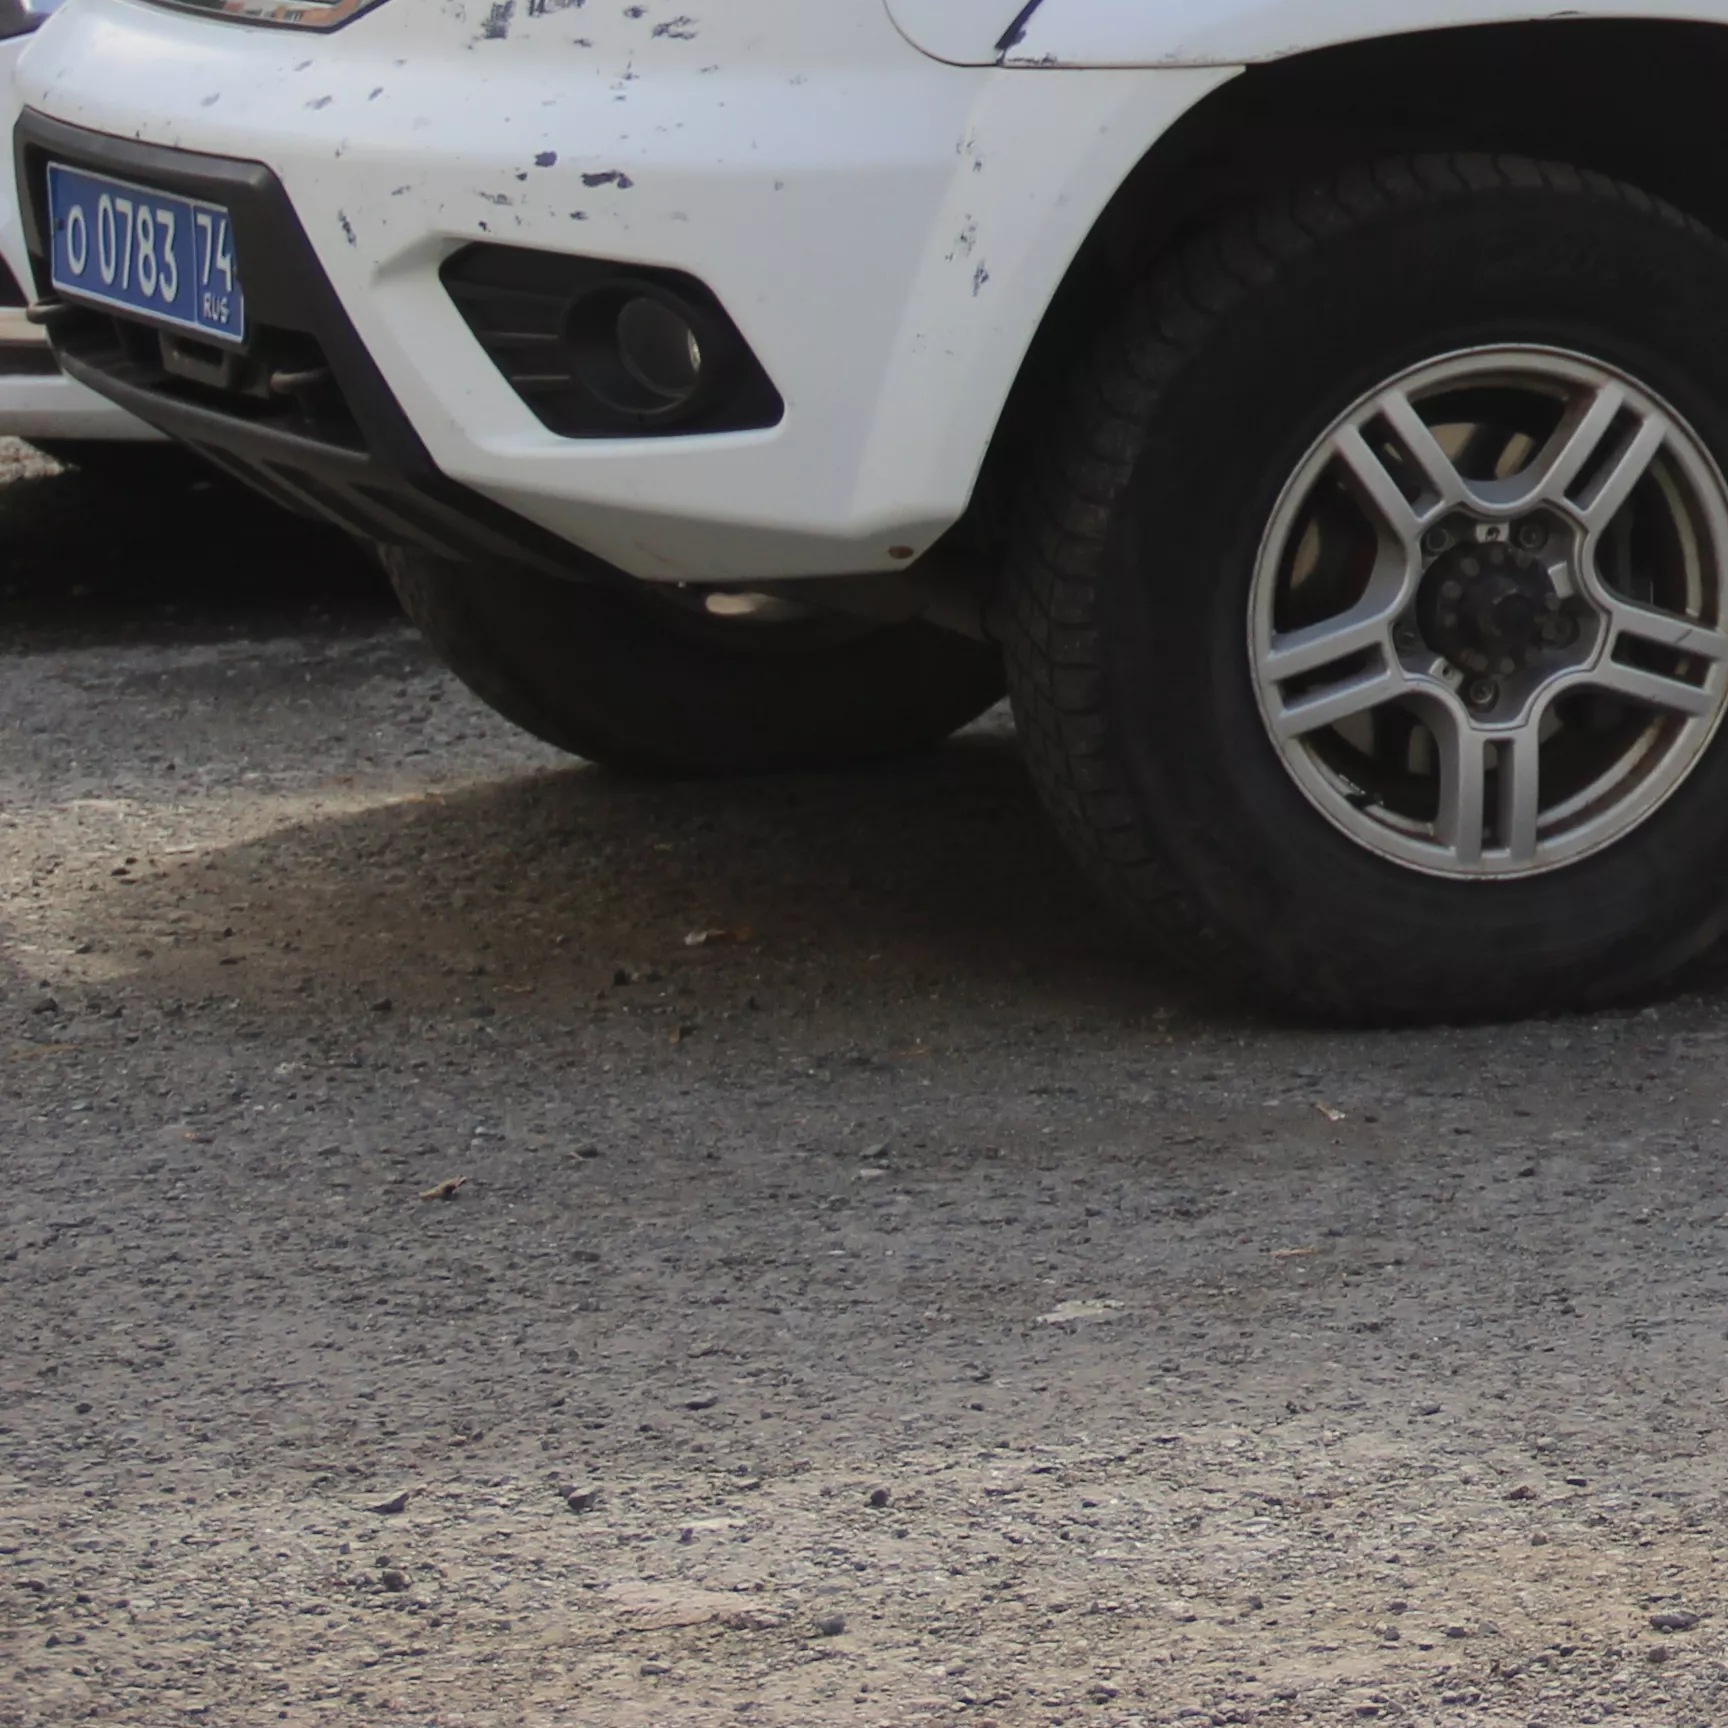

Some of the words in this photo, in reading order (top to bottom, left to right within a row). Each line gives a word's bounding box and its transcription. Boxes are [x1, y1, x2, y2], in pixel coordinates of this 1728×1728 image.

[99, 193, 178, 303] 0783
[197, 213, 233, 293] 74
[203, 291, 230, 324] RUS
